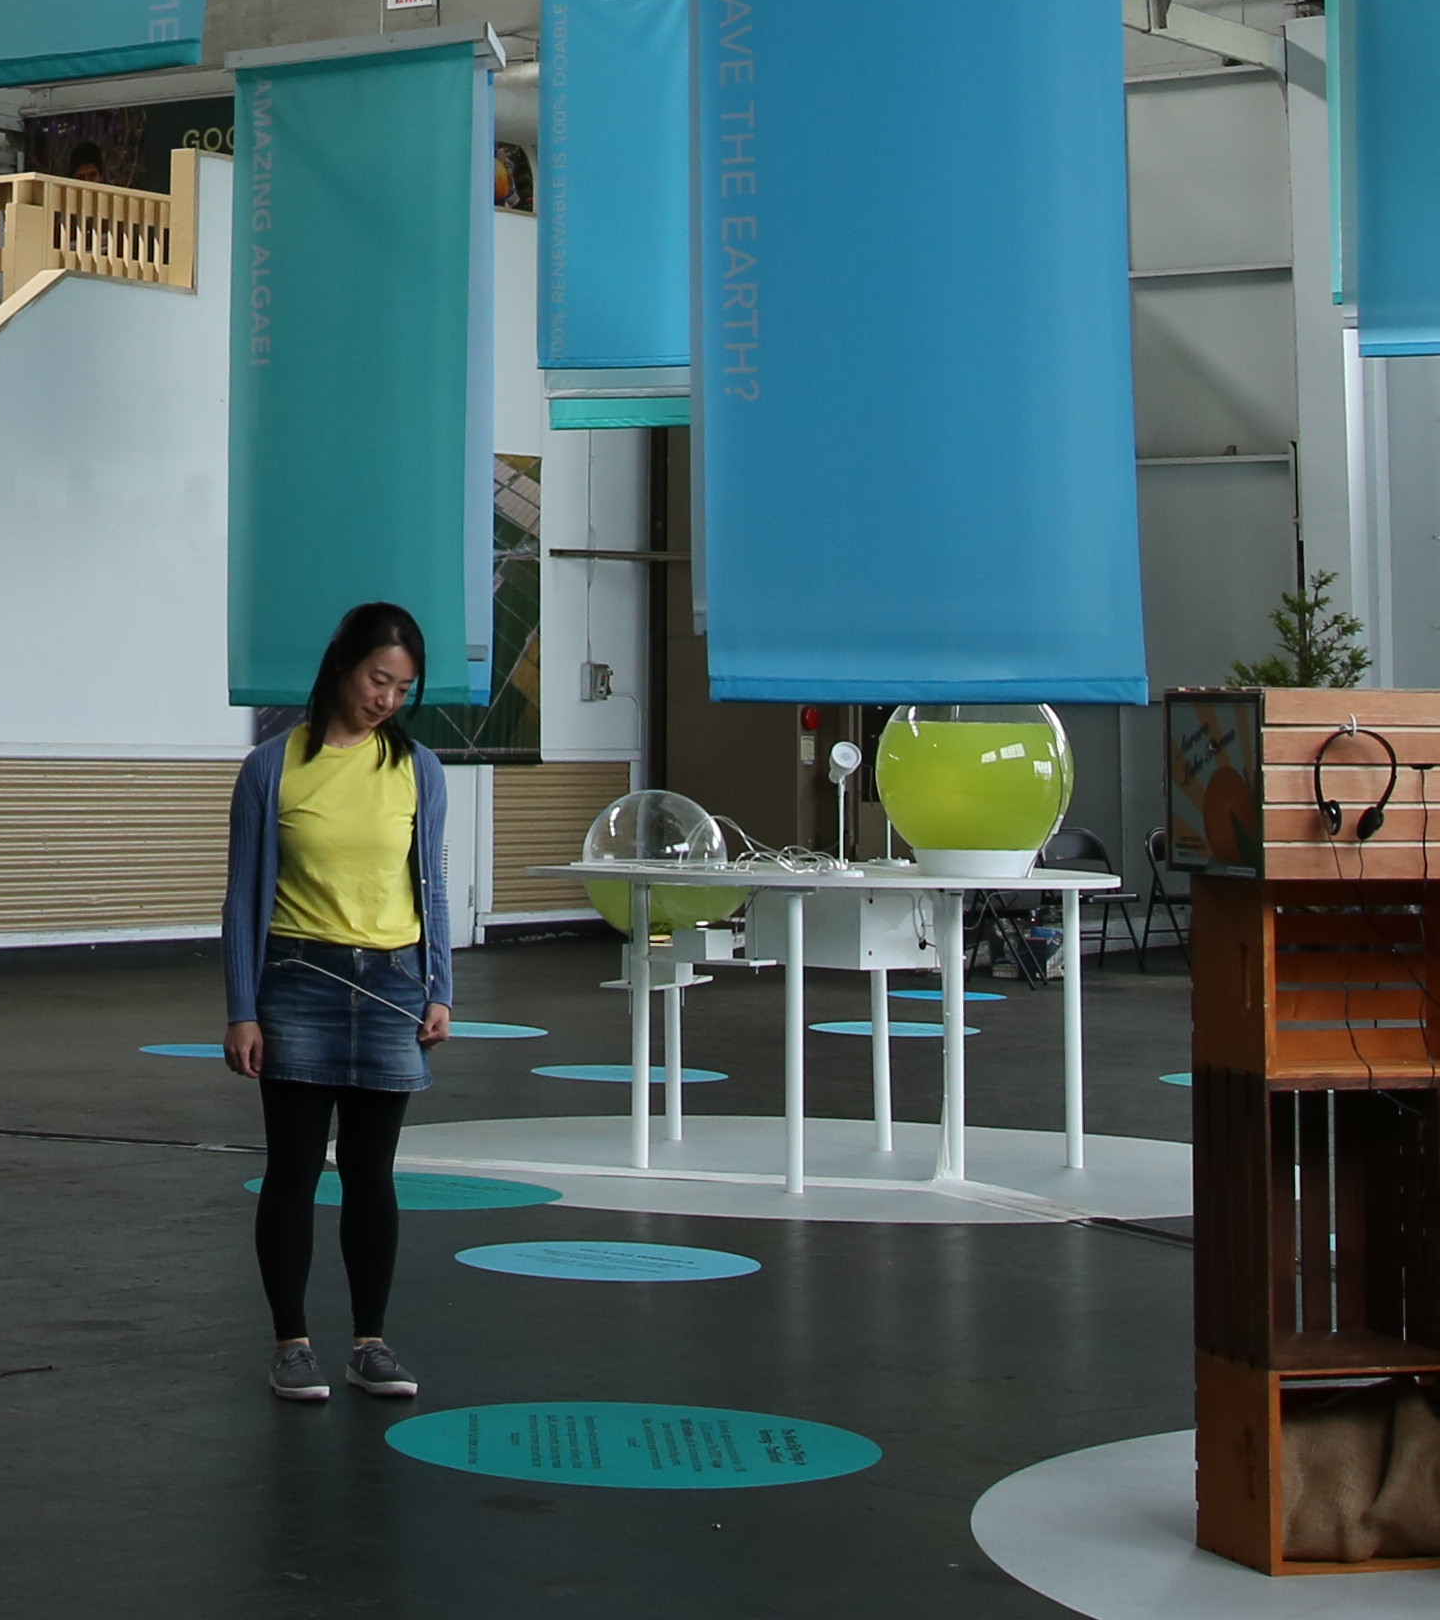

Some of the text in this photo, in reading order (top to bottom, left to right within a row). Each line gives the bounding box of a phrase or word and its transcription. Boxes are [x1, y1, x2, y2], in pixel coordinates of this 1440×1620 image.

[553, 2, 569, 86] DOABLE
[552, 152, 567, 168] IS
[719, 101, 756, 197] THE
[251, 81, 272, 367] AMAZING ALGAE!
[551, 176, 567, 302] RENEWABLE
[721, 216, 760, 402] EARTH?
